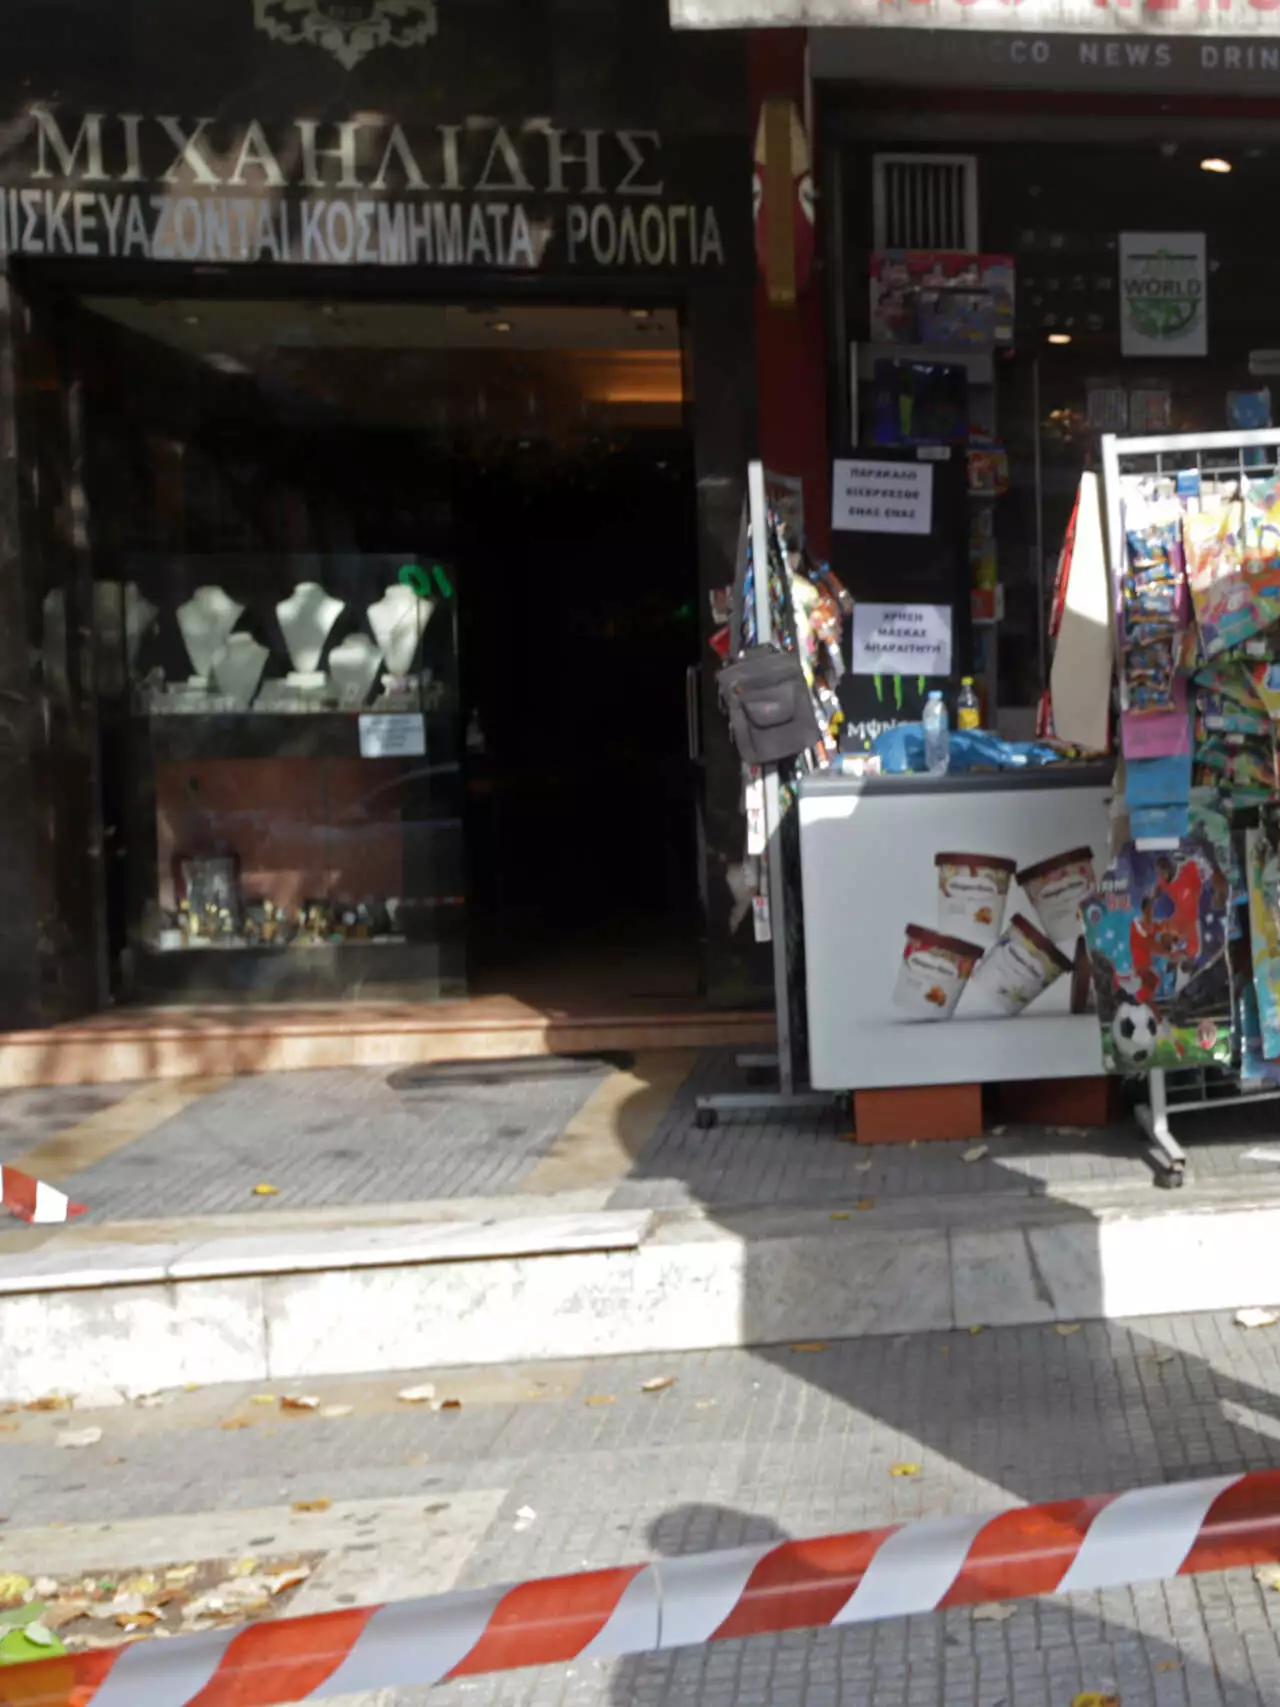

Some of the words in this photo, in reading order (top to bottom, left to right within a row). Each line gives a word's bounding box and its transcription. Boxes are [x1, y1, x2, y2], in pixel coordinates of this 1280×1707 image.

[1079, 41, 1172, 67] NEWS
[30, 107, 664, 195] ΜΙΧΑΗΛΙΔΗΣ
[302, 200, 537, 266] ΚΟΣΜΗΜΑΤΑ
[568, 204, 725, 265] ΡΟΛΟΓΙΑ
[1124, 278, 1201, 296] WORLD
